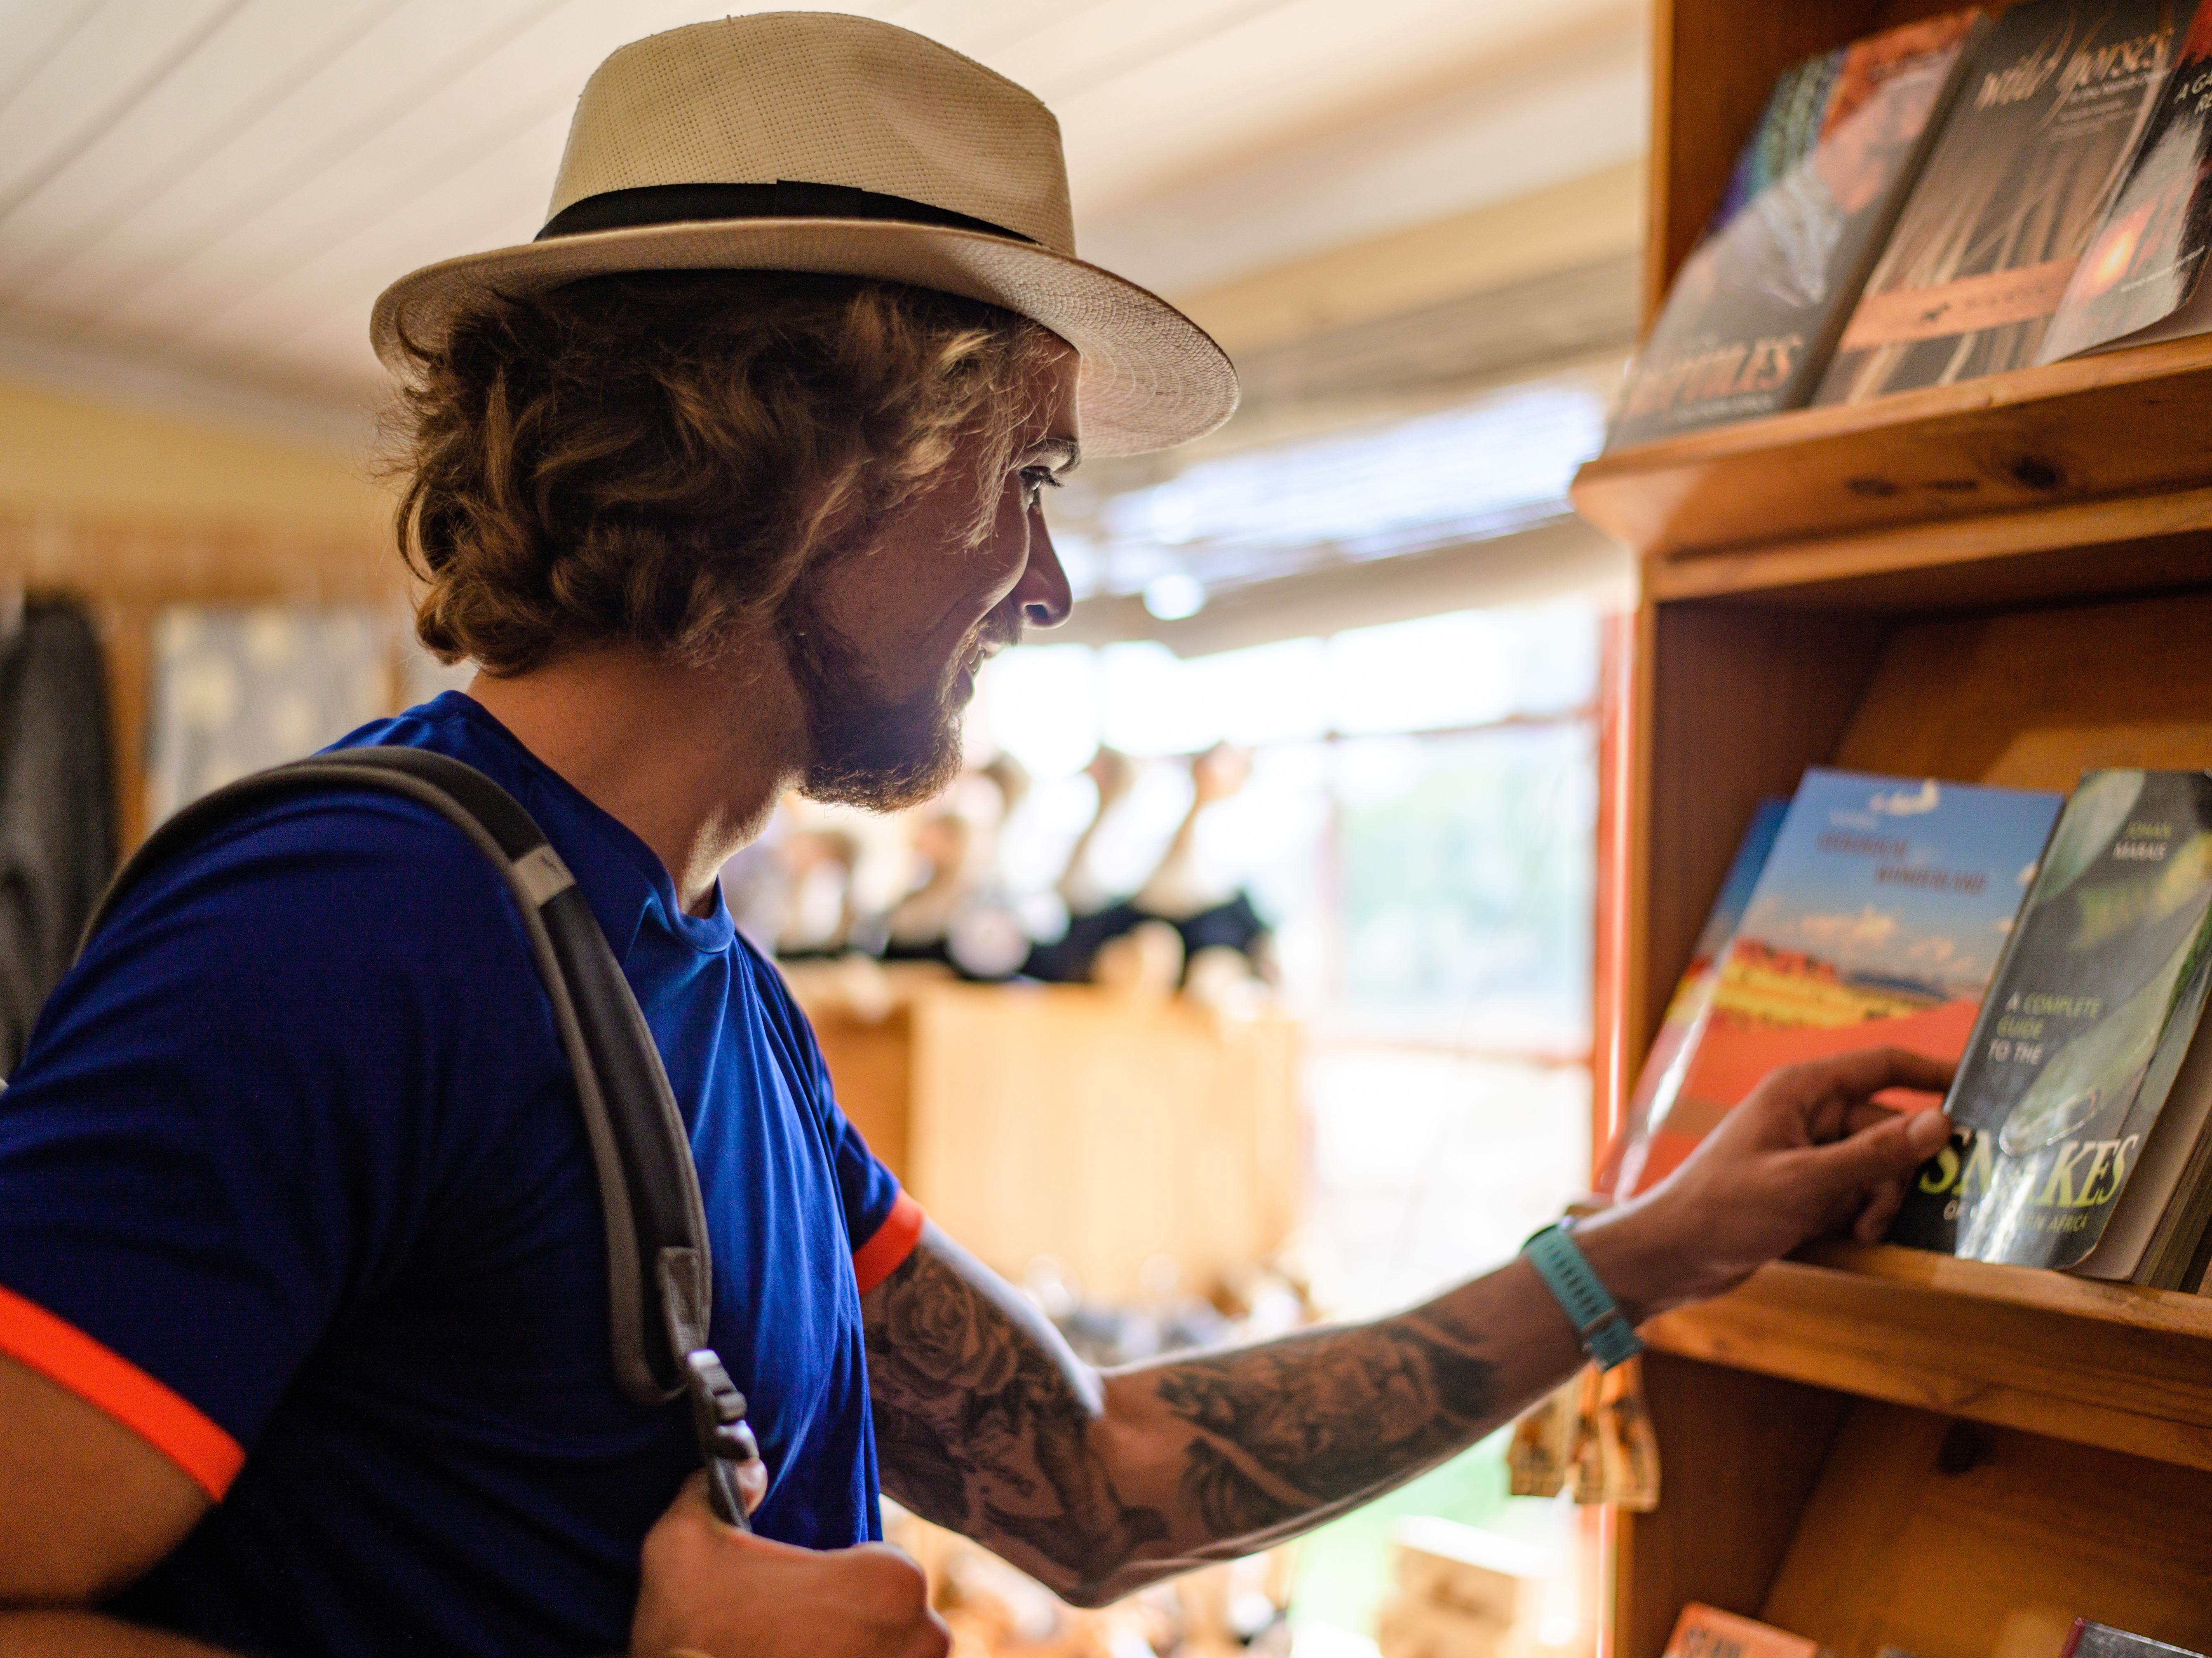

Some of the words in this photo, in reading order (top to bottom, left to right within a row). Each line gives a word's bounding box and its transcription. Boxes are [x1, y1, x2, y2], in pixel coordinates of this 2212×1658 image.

[2005, 990, 2019, 1012] A
[2023, 992, 2102, 1019] COMPLETE
[1996, 1014, 2044, 1039] GUIDE
[1987, 1039, 2011, 1062] TO
[2013, 1041, 2043, 1065] THE
[1918, 1126, 2140, 1208] SNKES
